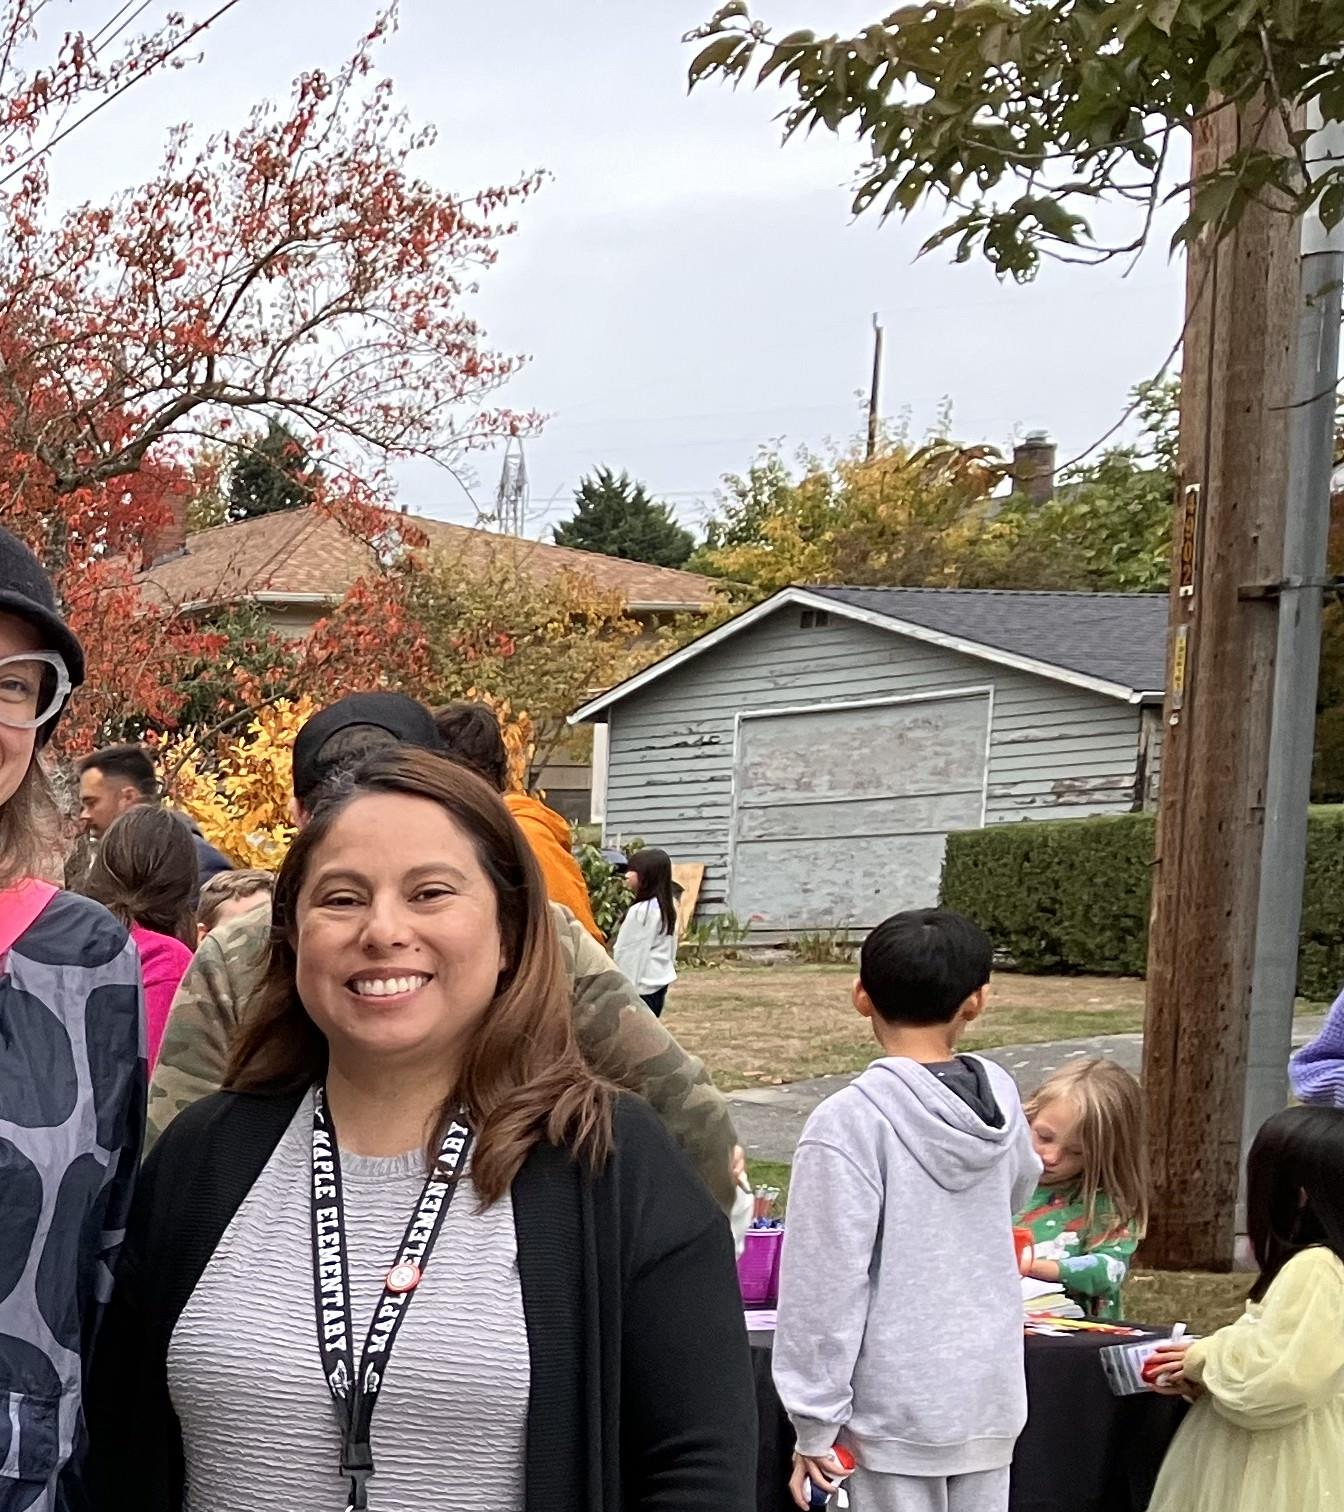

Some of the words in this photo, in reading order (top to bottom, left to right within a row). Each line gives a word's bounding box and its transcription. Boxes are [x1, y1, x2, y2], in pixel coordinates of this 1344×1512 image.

[312, 1130, 336, 1200] MAPLE
[316, 1206, 347, 1352] ELEMENTARY
[367, 1292, 408, 1354] MAPL
